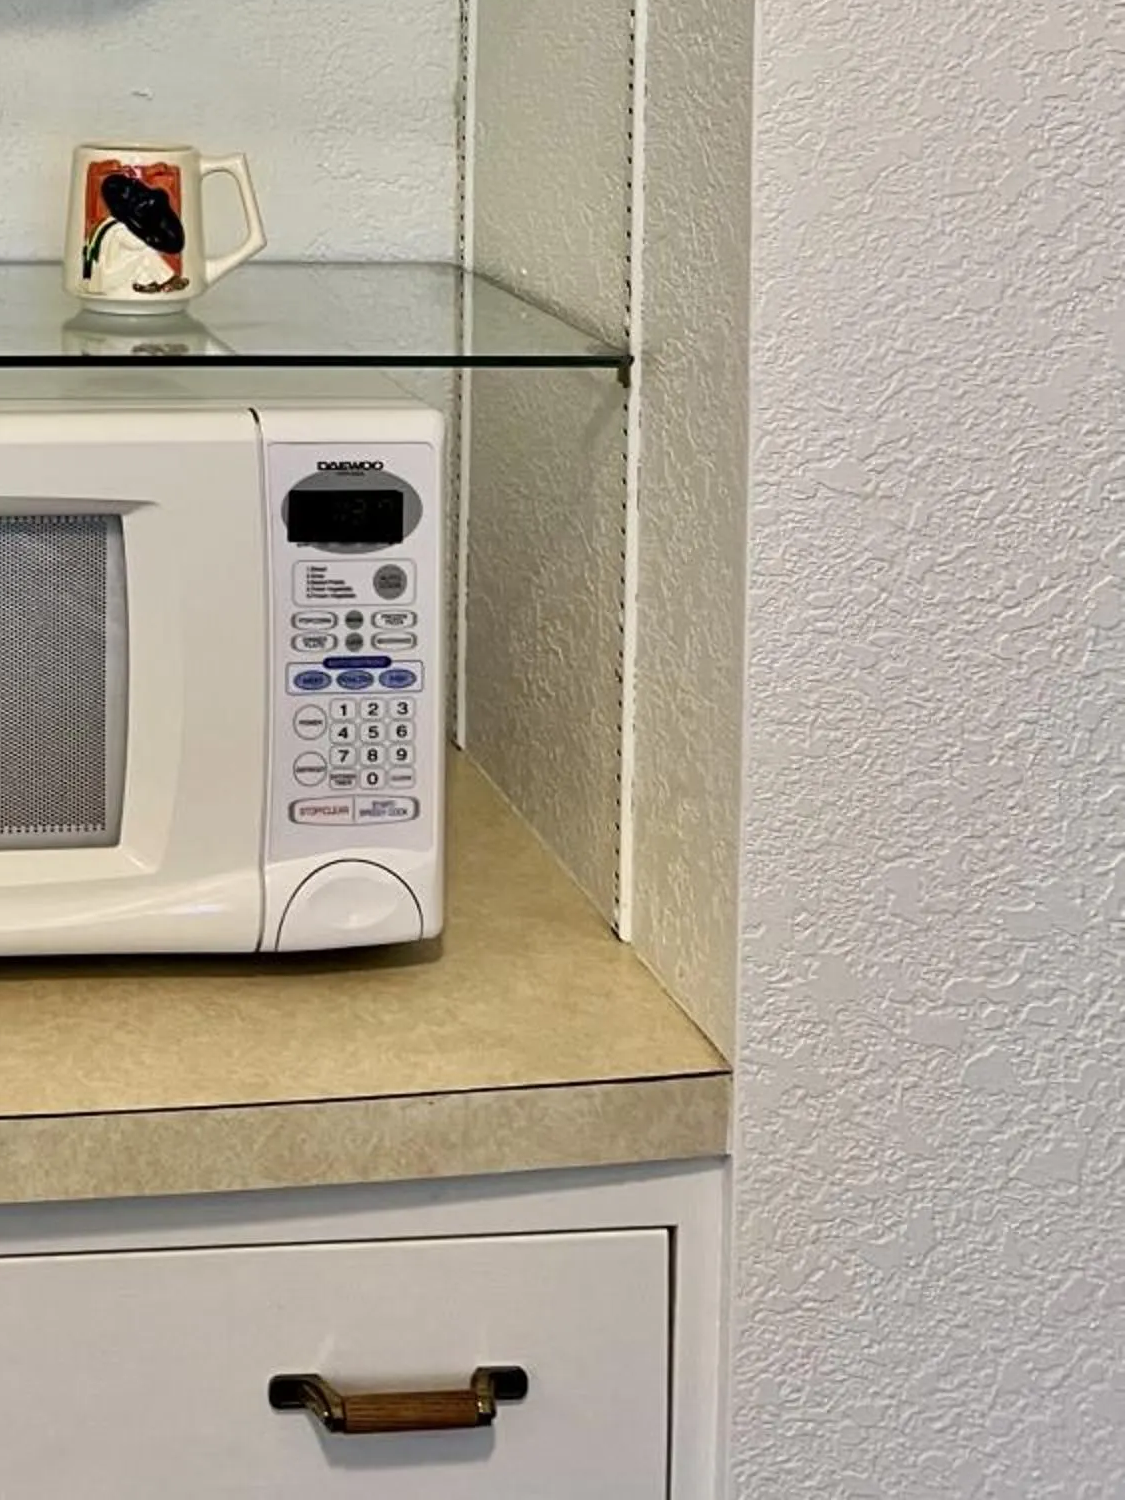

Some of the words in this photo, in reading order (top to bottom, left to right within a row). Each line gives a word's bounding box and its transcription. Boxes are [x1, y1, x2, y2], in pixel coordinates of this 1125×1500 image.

[317, 461, 384, 471] DAEWOO
[340, 703, 348, 716] 1
[368, 703, 379, 716] 2
[396, 702, 408, 716] 3
[337, 726, 348, 739] 4
[368, 725, 379, 739] 5
[396, 724, 407, 738] 6
[338, 749, 349, 763] 7
[367, 749, 378, 763] 8
[396, 747, 407, 761] 9
[366, 771, 379, 785] 0
